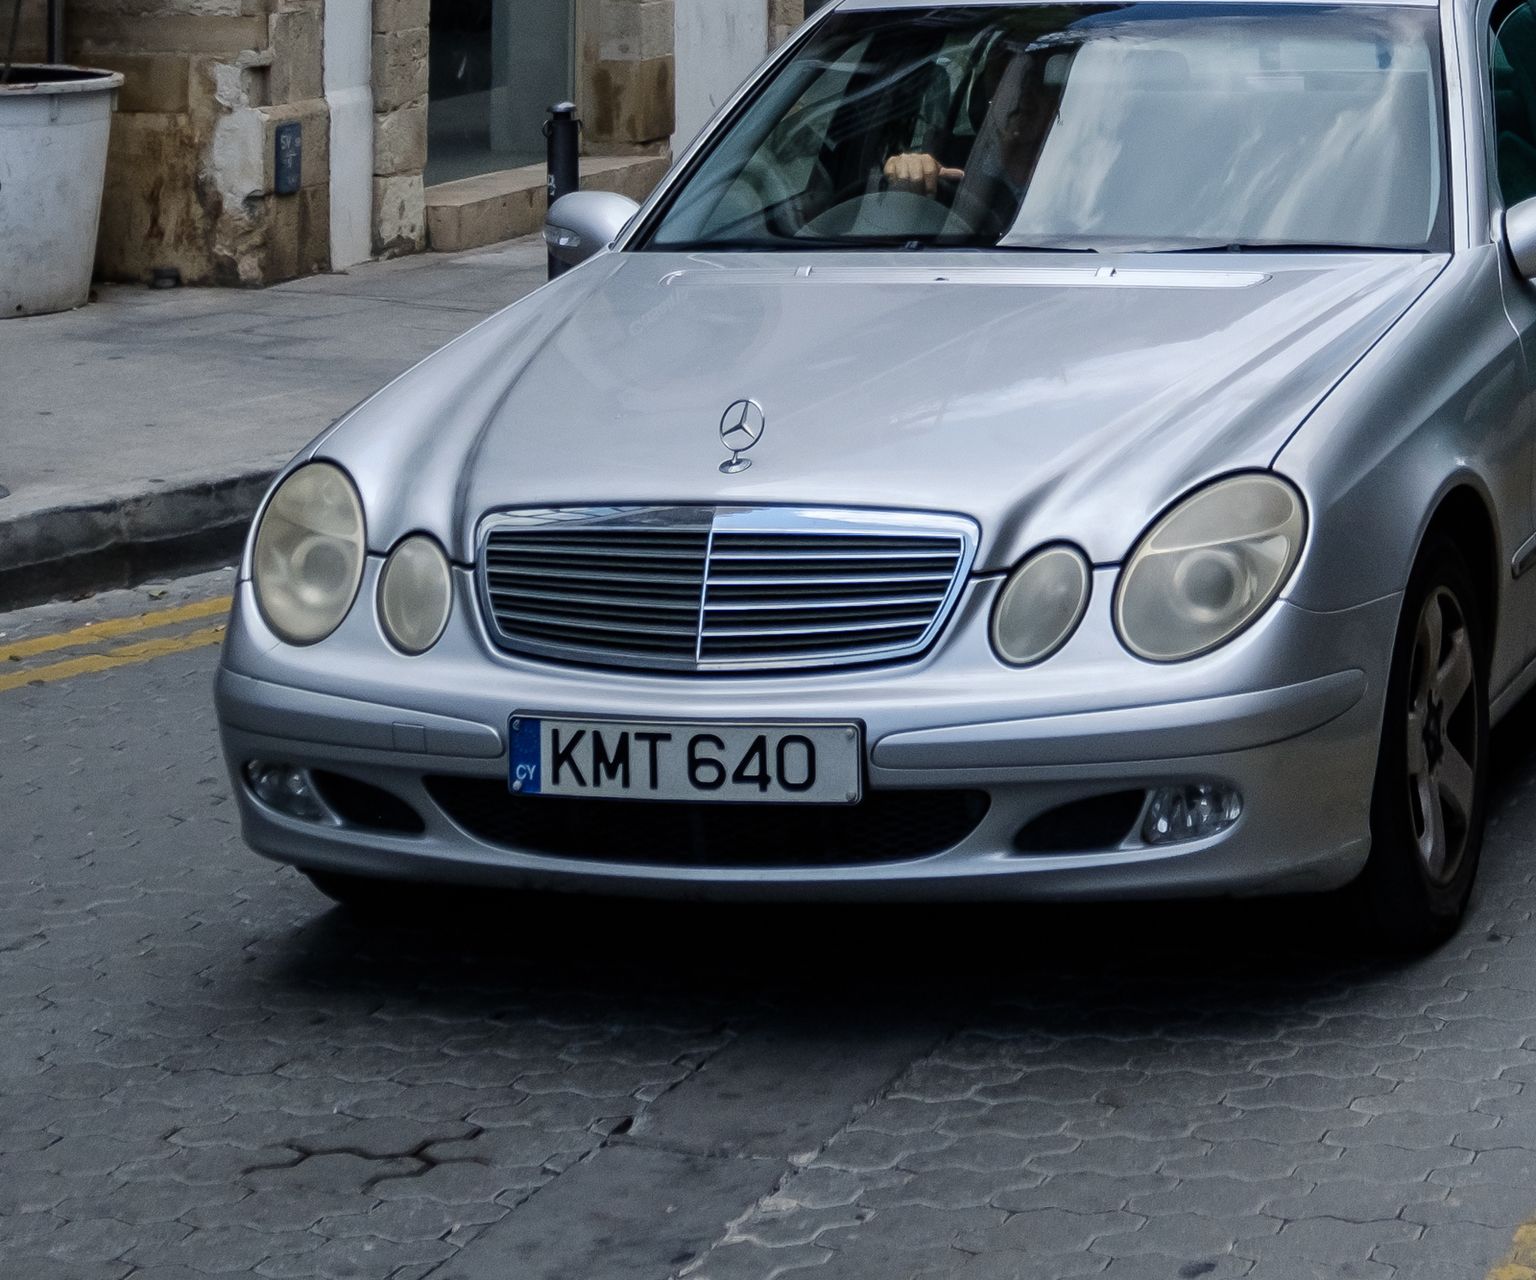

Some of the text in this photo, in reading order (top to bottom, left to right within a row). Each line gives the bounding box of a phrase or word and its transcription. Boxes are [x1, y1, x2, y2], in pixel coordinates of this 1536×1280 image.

[515, 728, 817, 793] CY KMT 640
